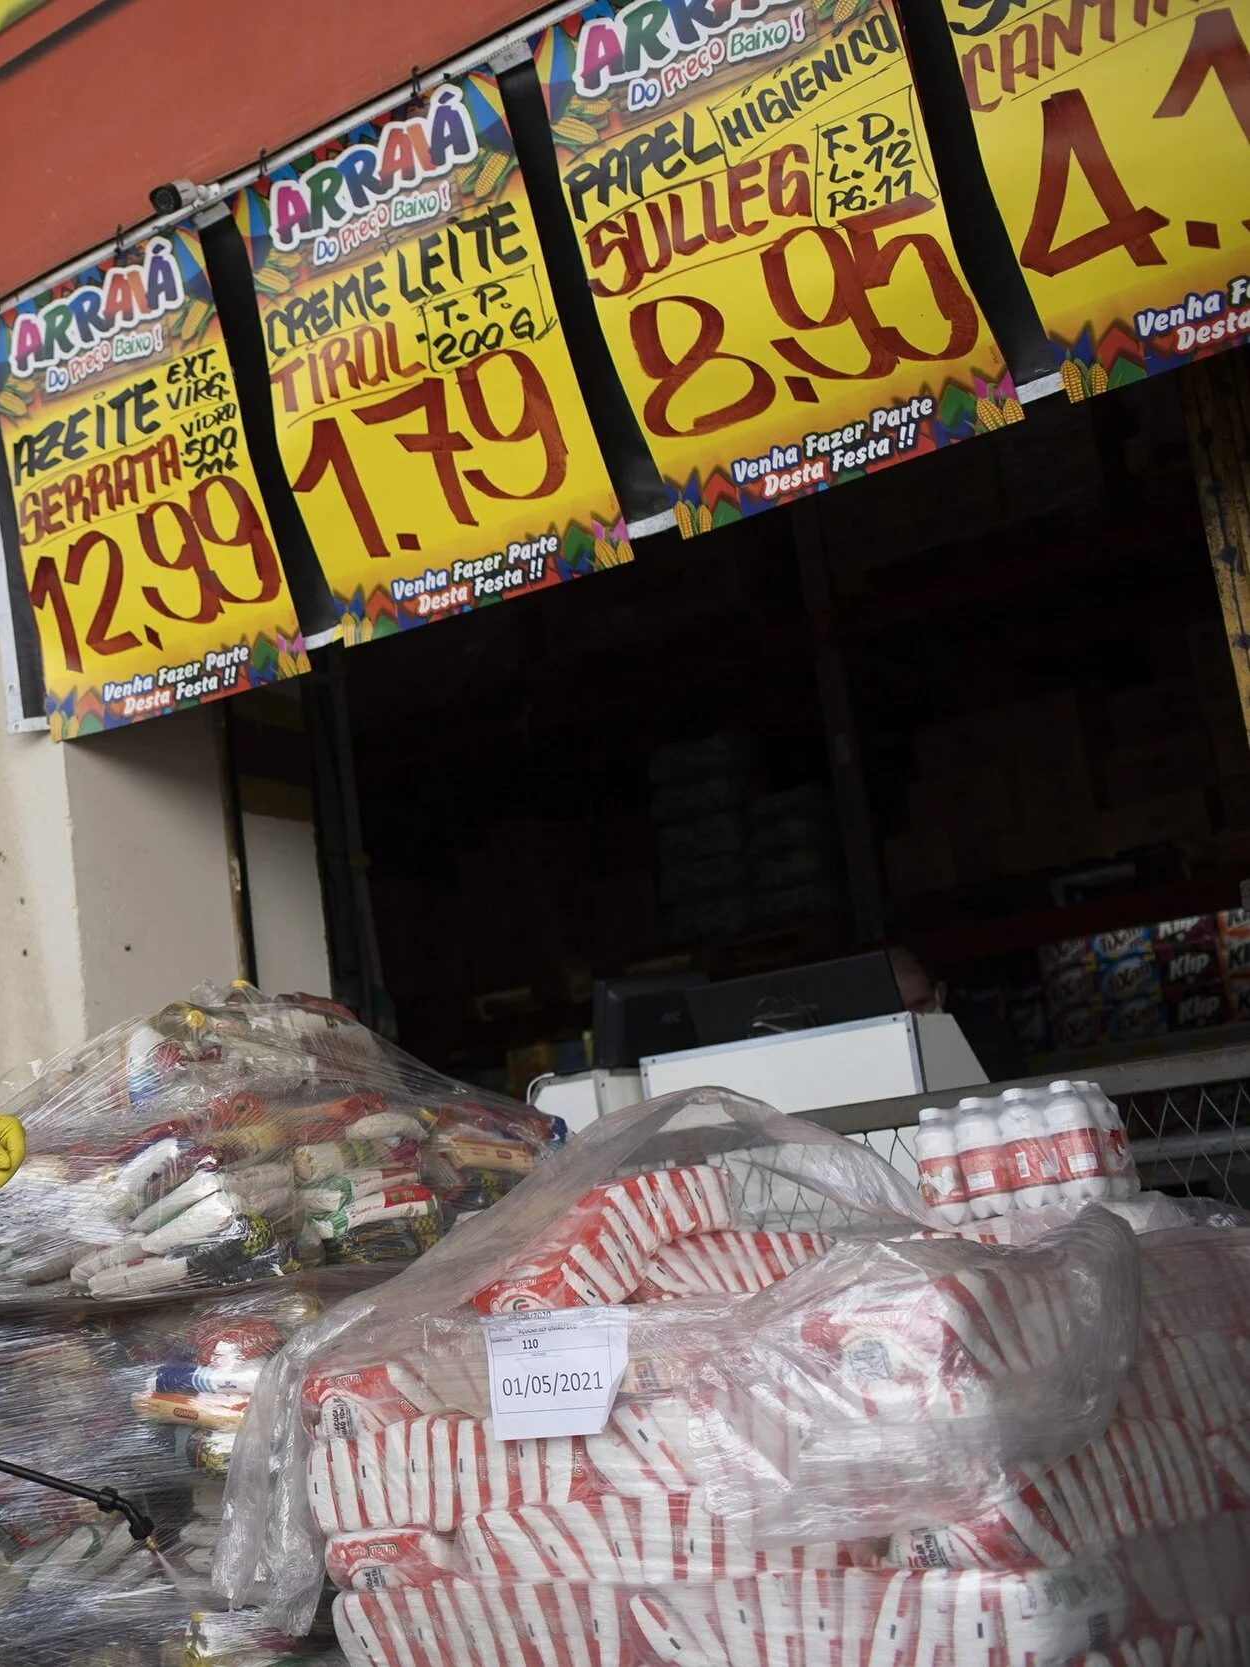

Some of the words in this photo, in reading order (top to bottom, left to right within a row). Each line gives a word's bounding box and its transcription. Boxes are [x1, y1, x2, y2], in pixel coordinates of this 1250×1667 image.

[631, 82, 657, 106] Do
[664, 41, 724, 94] Preço
[276, 90, 471, 245] ARRAIÁ
[563, 111, 723, 223] PAPEL
[317, 240, 337, 260] Do
[341, 208, 388, 249] Preço
[585, 143, 813, 297] SULLEG
[14, 243, 178, 372] ARRAIÁ
[265, 261, 391, 356] CREME
[397, 201, 528, 304] LEITE
[1138, 294, 1220, 336] Venha
[629, 195, 979, 438] 8.95
[48, 369, 66, 388] Do
[70, 343, 111, 380] Preço
[269, 321, 427, 413] TIROL
[13, 378, 161, 487] AZEITE
[293, 348, 570, 558] 1.79
[733, 445, 798, 483] Venha
[805, 423, 865, 457] Fazer
[872, 398, 933, 432] Parte
[19, 434, 183, 546] SERRATA
[764, 461, 824, 496] Desta
[391, 571, 447, 600] Venha
[452, 554, 502, 582] Fazer
[508, 536, 558, 564] Parte
[418, 586, 468, 614] Desta
[104, 675, 153, 702] Venha
[158, 661, 201, 686] Fazer
[205, 646, 249, 671] Parte
[124, 690, 171, 715] Desta
[522, 1339, 539, 1349] 110
[502, 1371, 603, 1398] 01/05/2021
